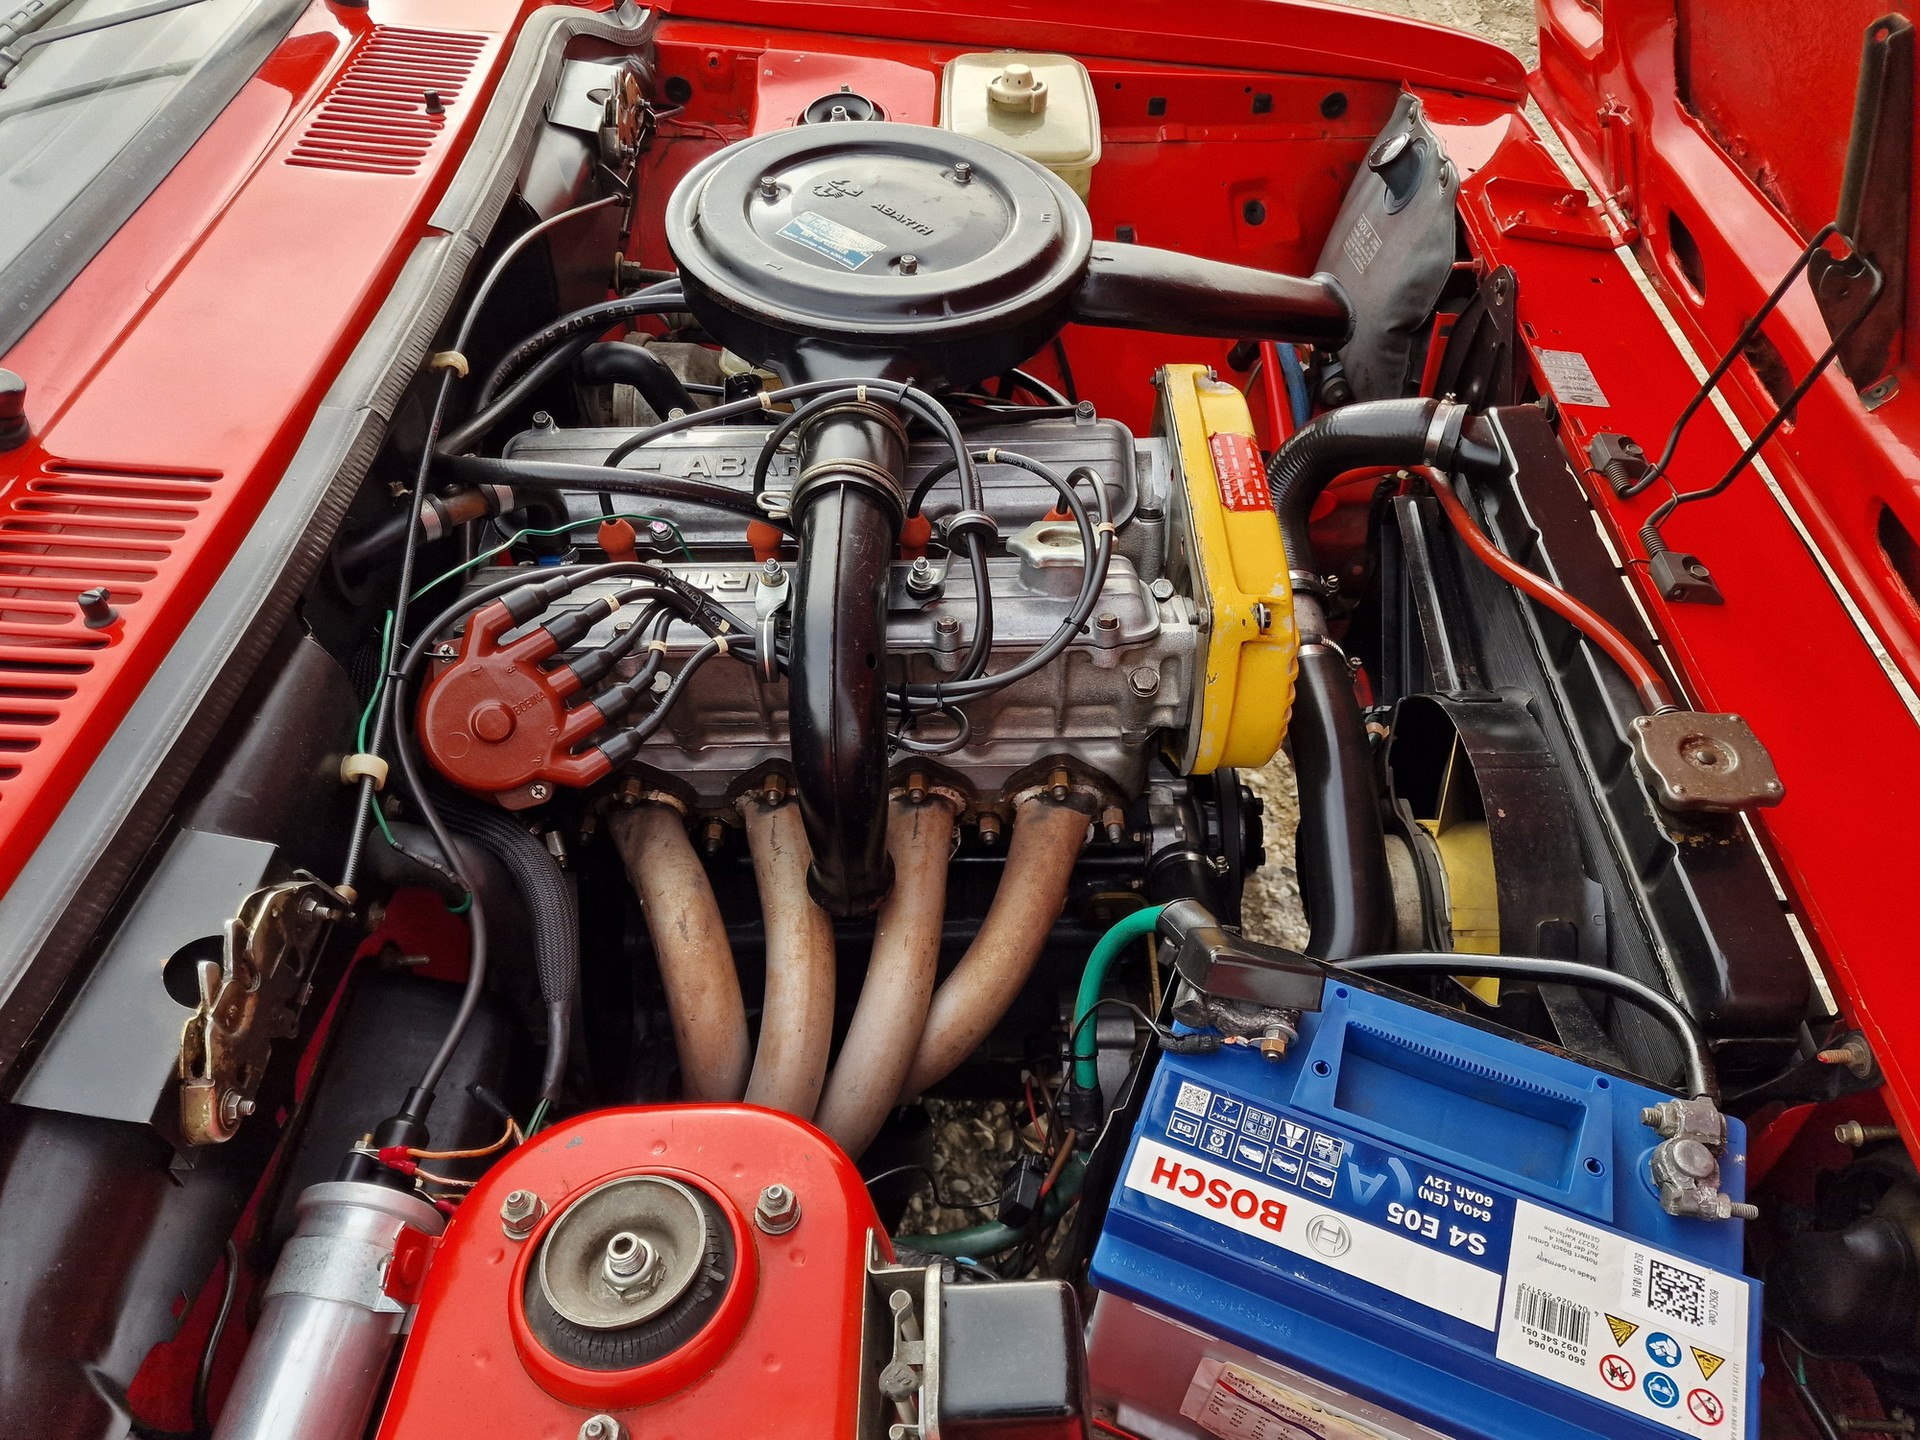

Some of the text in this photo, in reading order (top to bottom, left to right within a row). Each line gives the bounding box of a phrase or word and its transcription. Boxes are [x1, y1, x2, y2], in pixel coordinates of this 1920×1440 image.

[871, 204, 934, 236] ABARTH
[1357, 219, 1372, 240] SOLA
[495, 362, 512, 386] DIN
[513, 330, 556, 362] 73379
[512, 690, 547, 716] BOBINA
[1177, 1122, 1192, 1132] EFB
[1212, 1128, 1227, 1137] STOP
[1206, 1144, 1223, 1154] START
[1150, 1156, 1288, 1232] BOSCH
[1424, 1174, 1494, 1208] 60Ah 12V
[1418, 1186, 1492, 1222] 640A (EN)
[1387, 1202, 1488, 1256] S4 E05
[1544, 1225, 1577, 1244] Karlsruhe
[1565, 1226, 1600, 1243] GERMANY
[1528, 1235, 1598, 1266] Robert Bosch GmbH
[1556, 1238, 1572, 1248] Breit
[1586, 1248, 1600, 1258] Auf
[1536, 1254, 1567, 1271] Germany
[1576, 1270, 1597, 1282] Made
[1708, 1288, 1719, 1326] BOSCH Code
[1521, 1326, 1538, 1338] 051
[1540, 1333, 1559, 1346] S4E
[1528, 1338, 1586, 1366] 560 500 064
[1561, 1342, 1579, 1353] 092
[1226, 1371, 1267, 1399] Starter
[1272, 1398, 1326, 1429] batteries
